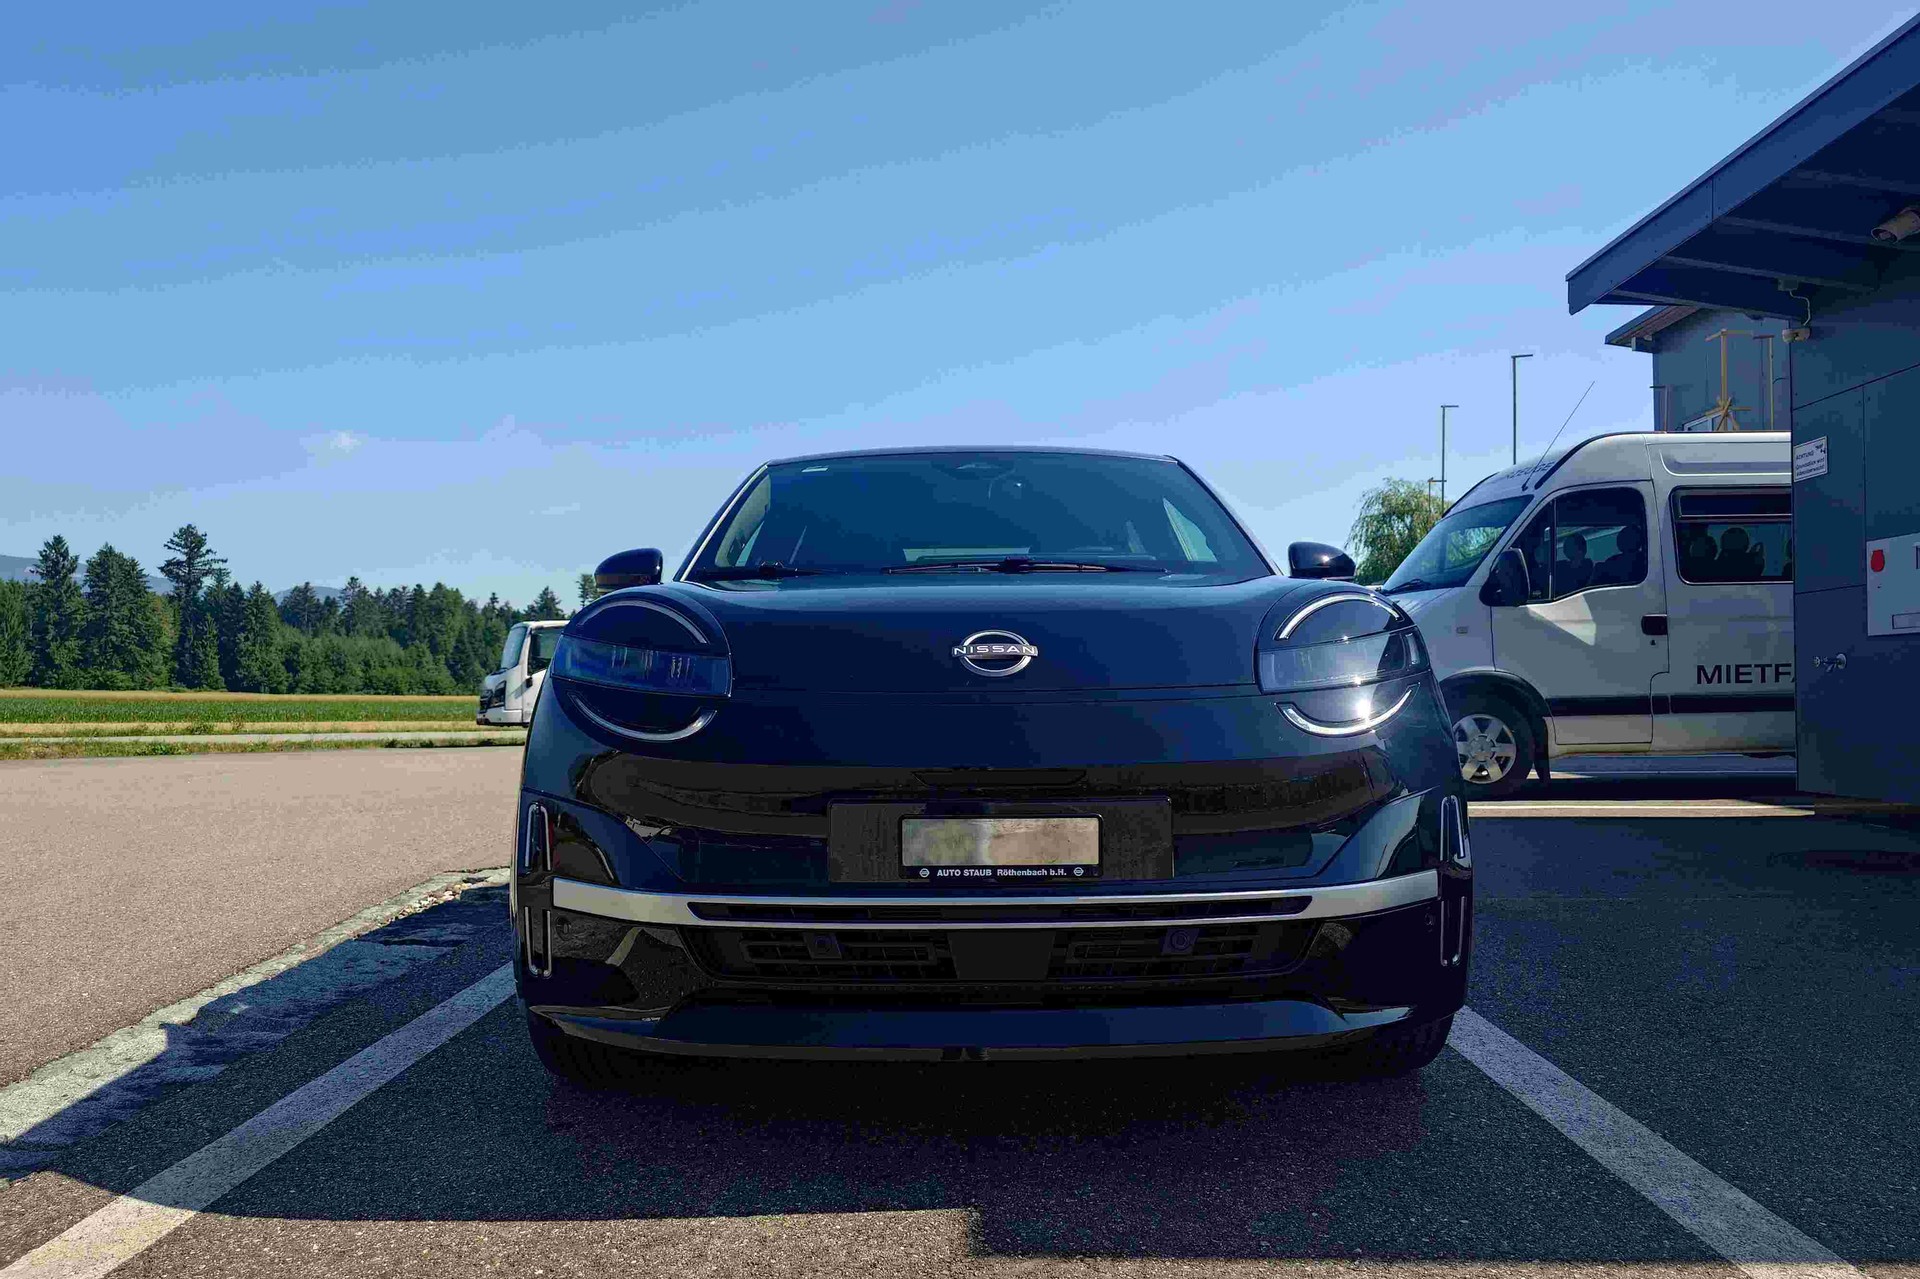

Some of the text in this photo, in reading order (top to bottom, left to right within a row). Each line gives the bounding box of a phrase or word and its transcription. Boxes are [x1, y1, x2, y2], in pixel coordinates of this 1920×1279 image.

[954, 645, 1036, 655] NISSAN
[1697, 663, 1795, 684] MIETF
[937, 868, 1067, 877] AUTO STAUB Röthenbach b.H.
